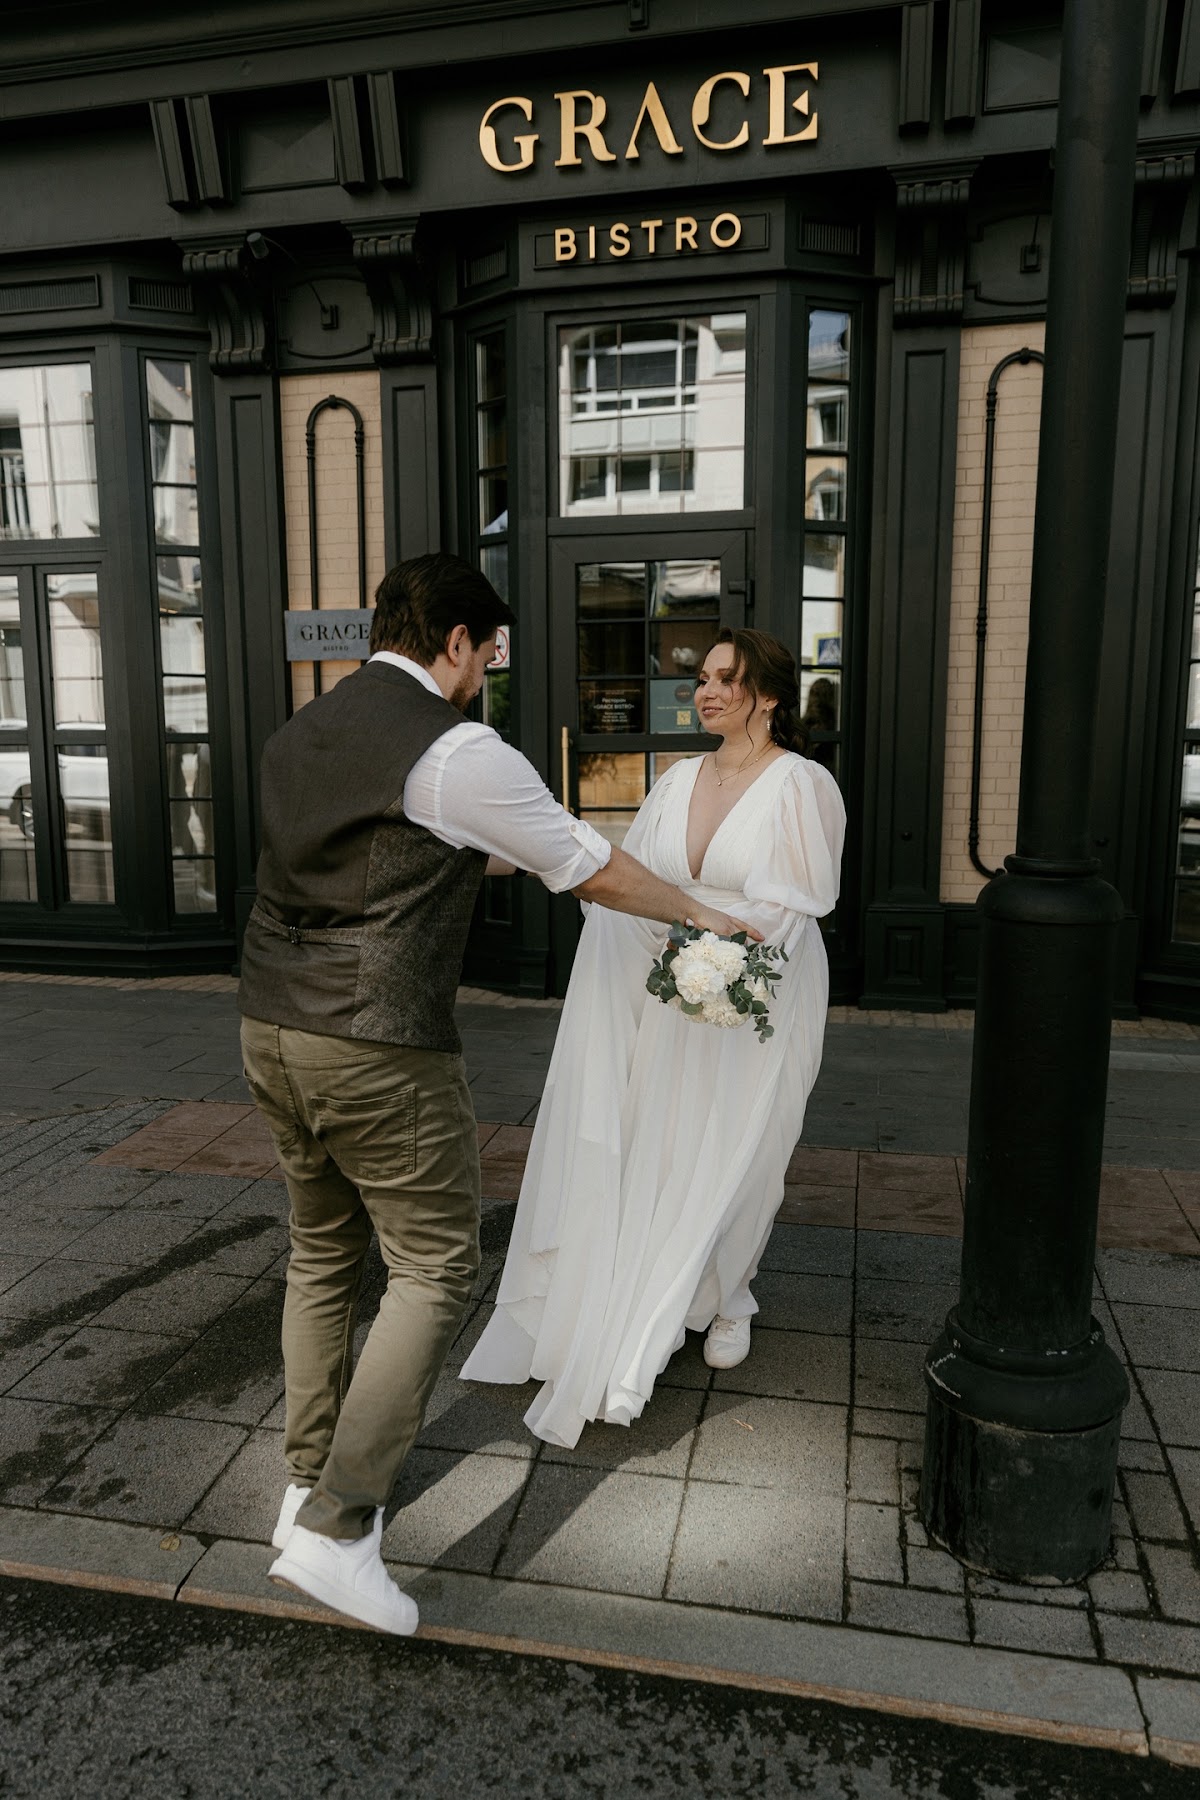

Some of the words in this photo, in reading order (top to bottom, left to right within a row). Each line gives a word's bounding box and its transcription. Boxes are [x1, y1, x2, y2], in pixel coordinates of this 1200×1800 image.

[478, 61, 819, 173] GRACE
[554, 212, 742, 262] BISTRO
[300, 623, 370, 641] GRACE
